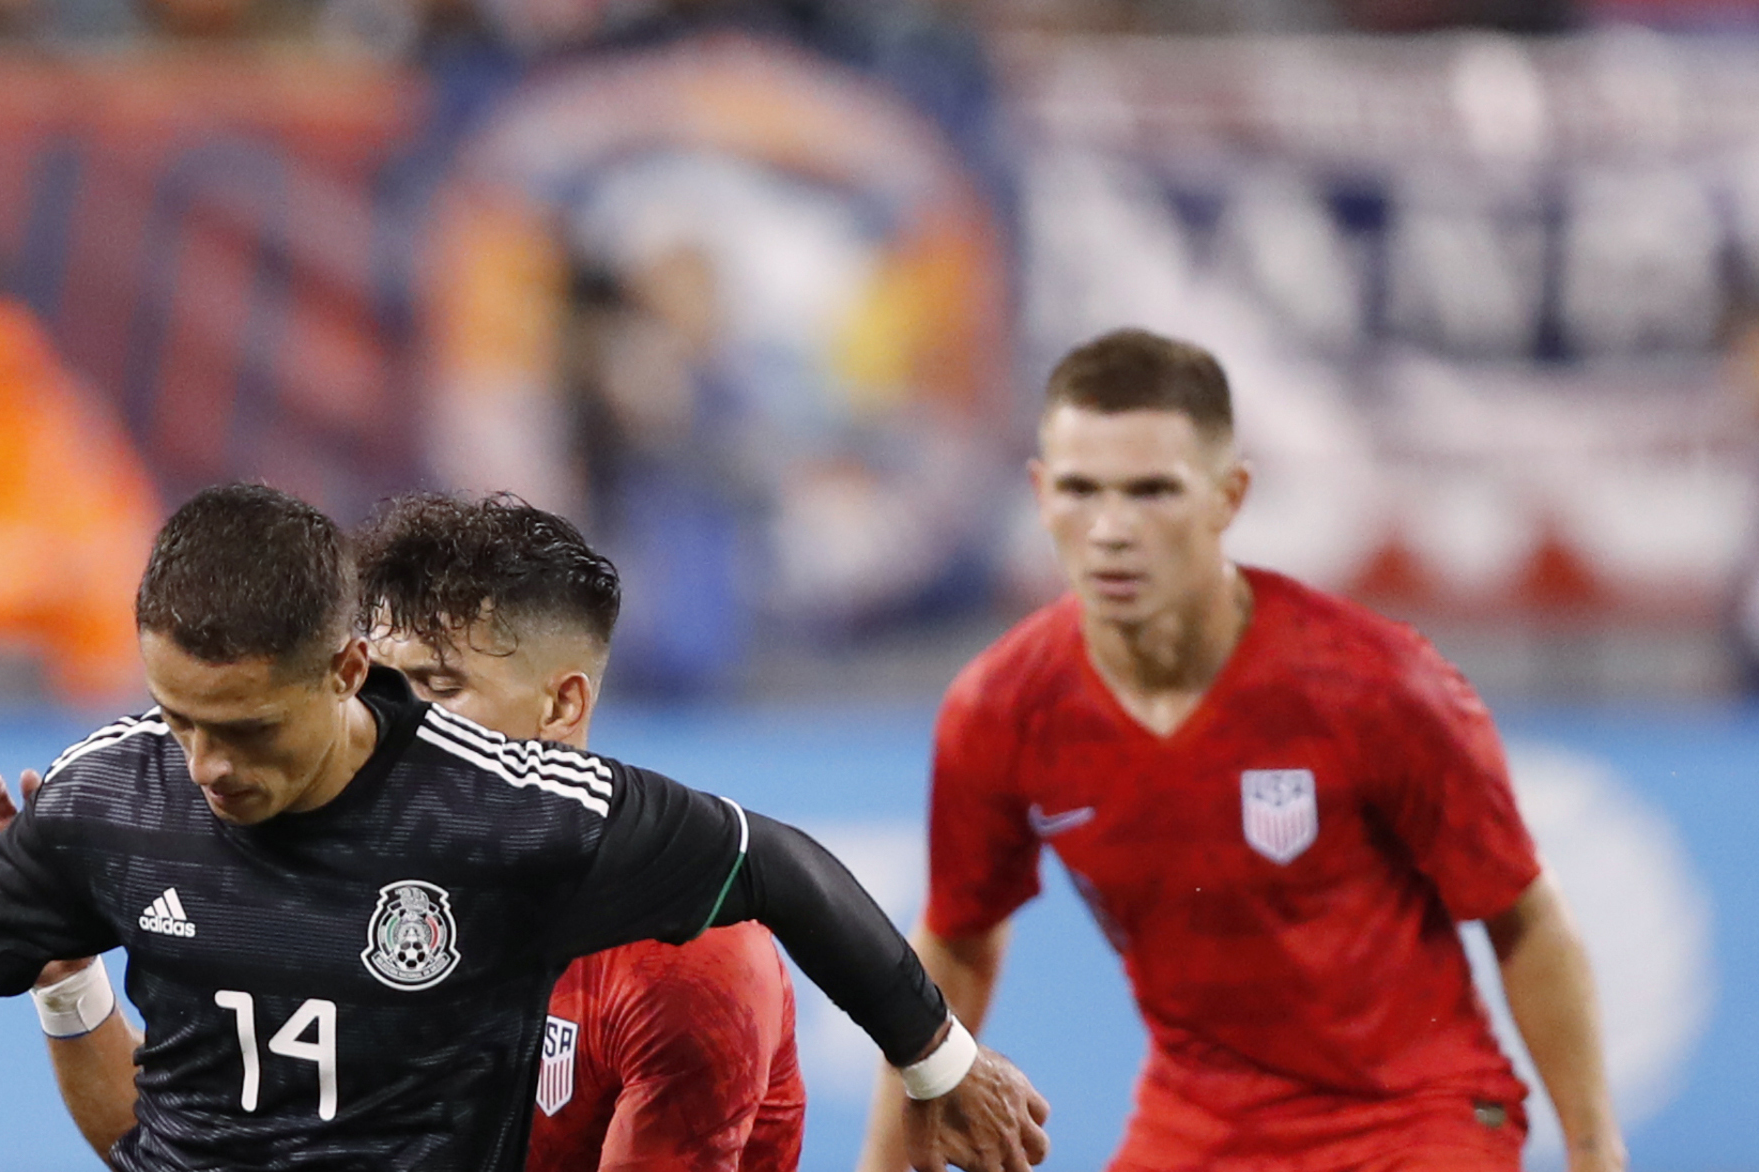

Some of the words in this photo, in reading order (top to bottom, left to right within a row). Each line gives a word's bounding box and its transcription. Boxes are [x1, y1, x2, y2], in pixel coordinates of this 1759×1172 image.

[138, 915, 196, 938] adidas
[215, 989, 337, 1122] 14
[545, 1021, 573, 1058] SA
